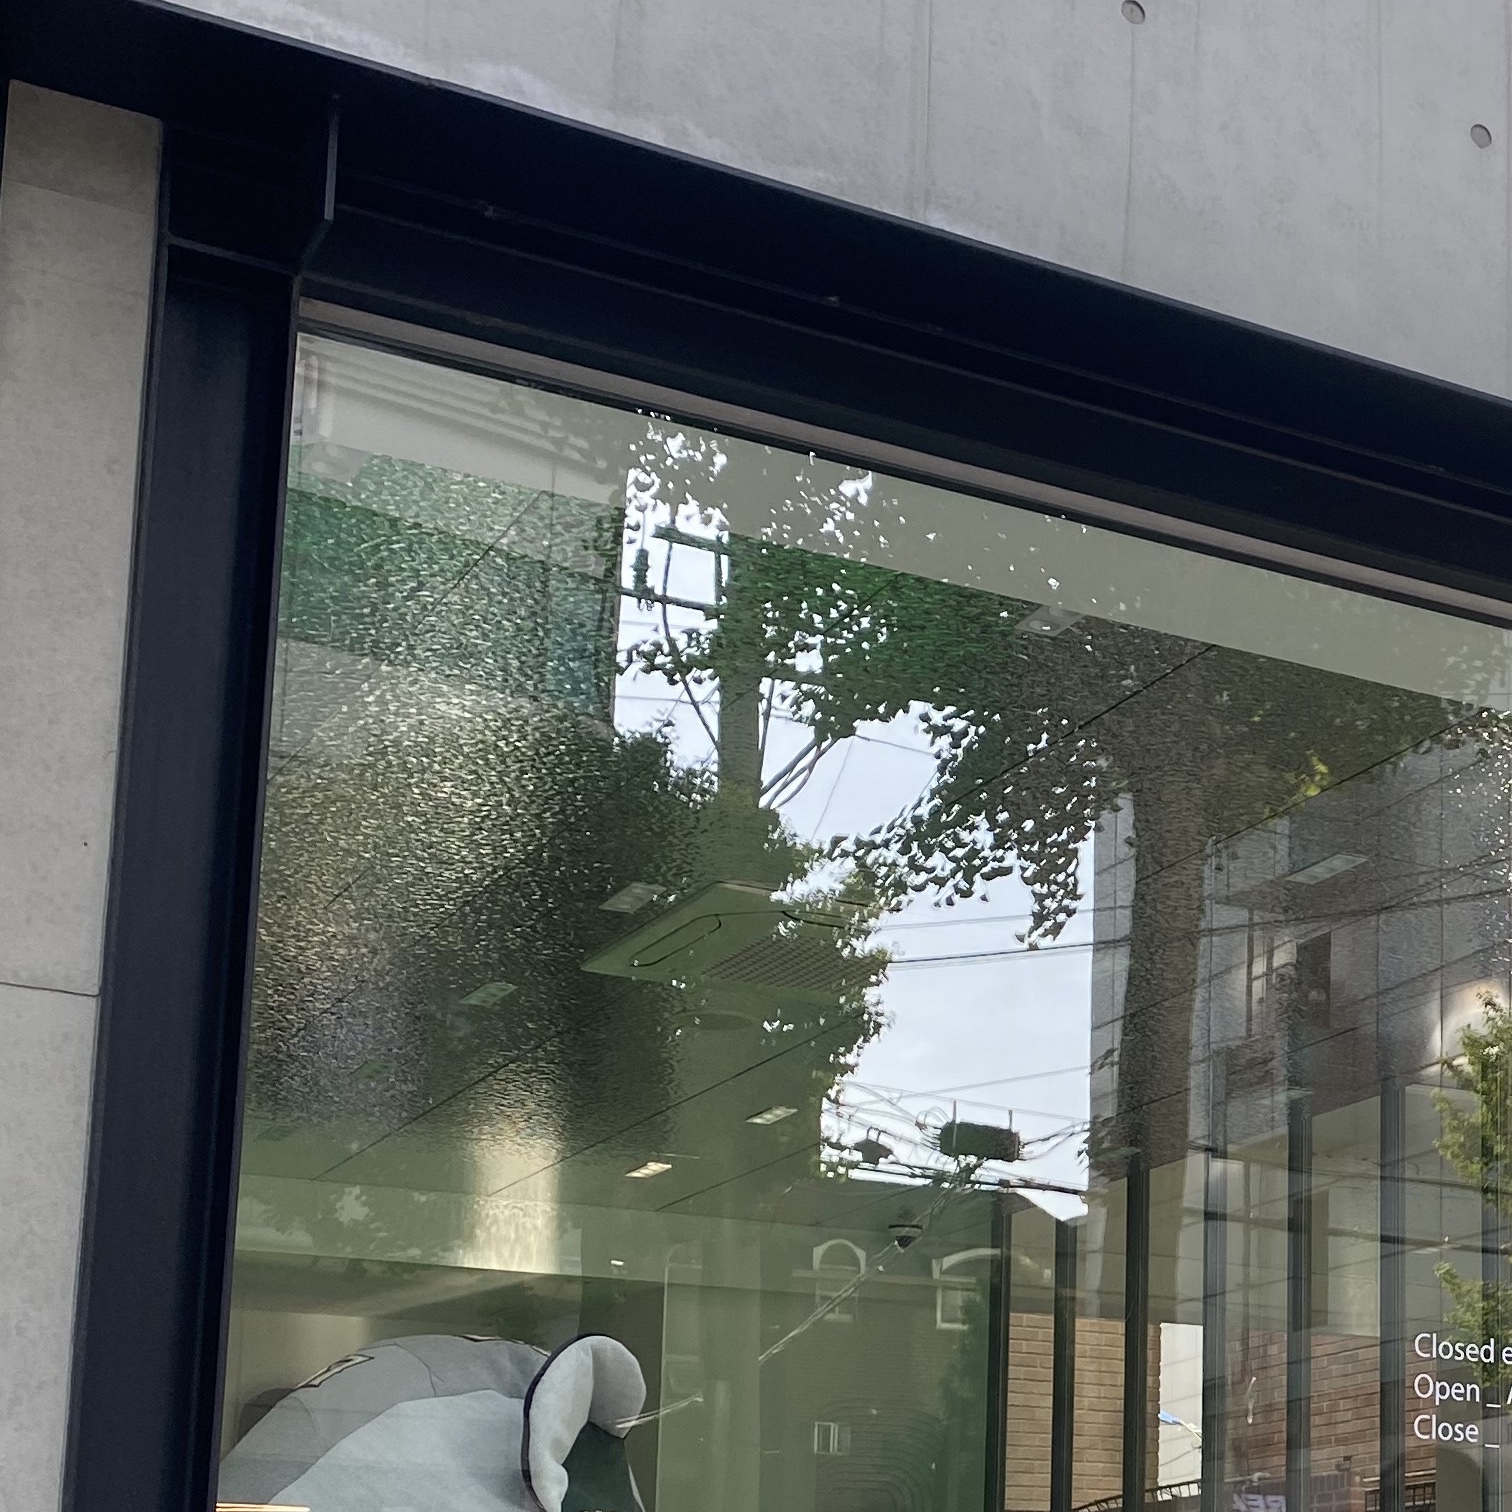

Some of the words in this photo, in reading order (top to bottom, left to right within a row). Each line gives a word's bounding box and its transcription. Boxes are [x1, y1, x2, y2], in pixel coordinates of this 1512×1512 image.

[1414, 1332, 1495, 1364] Closed
[1413, 1373, 1480, 1406] Open
[1413, 1413, 1479, 1443] Close
